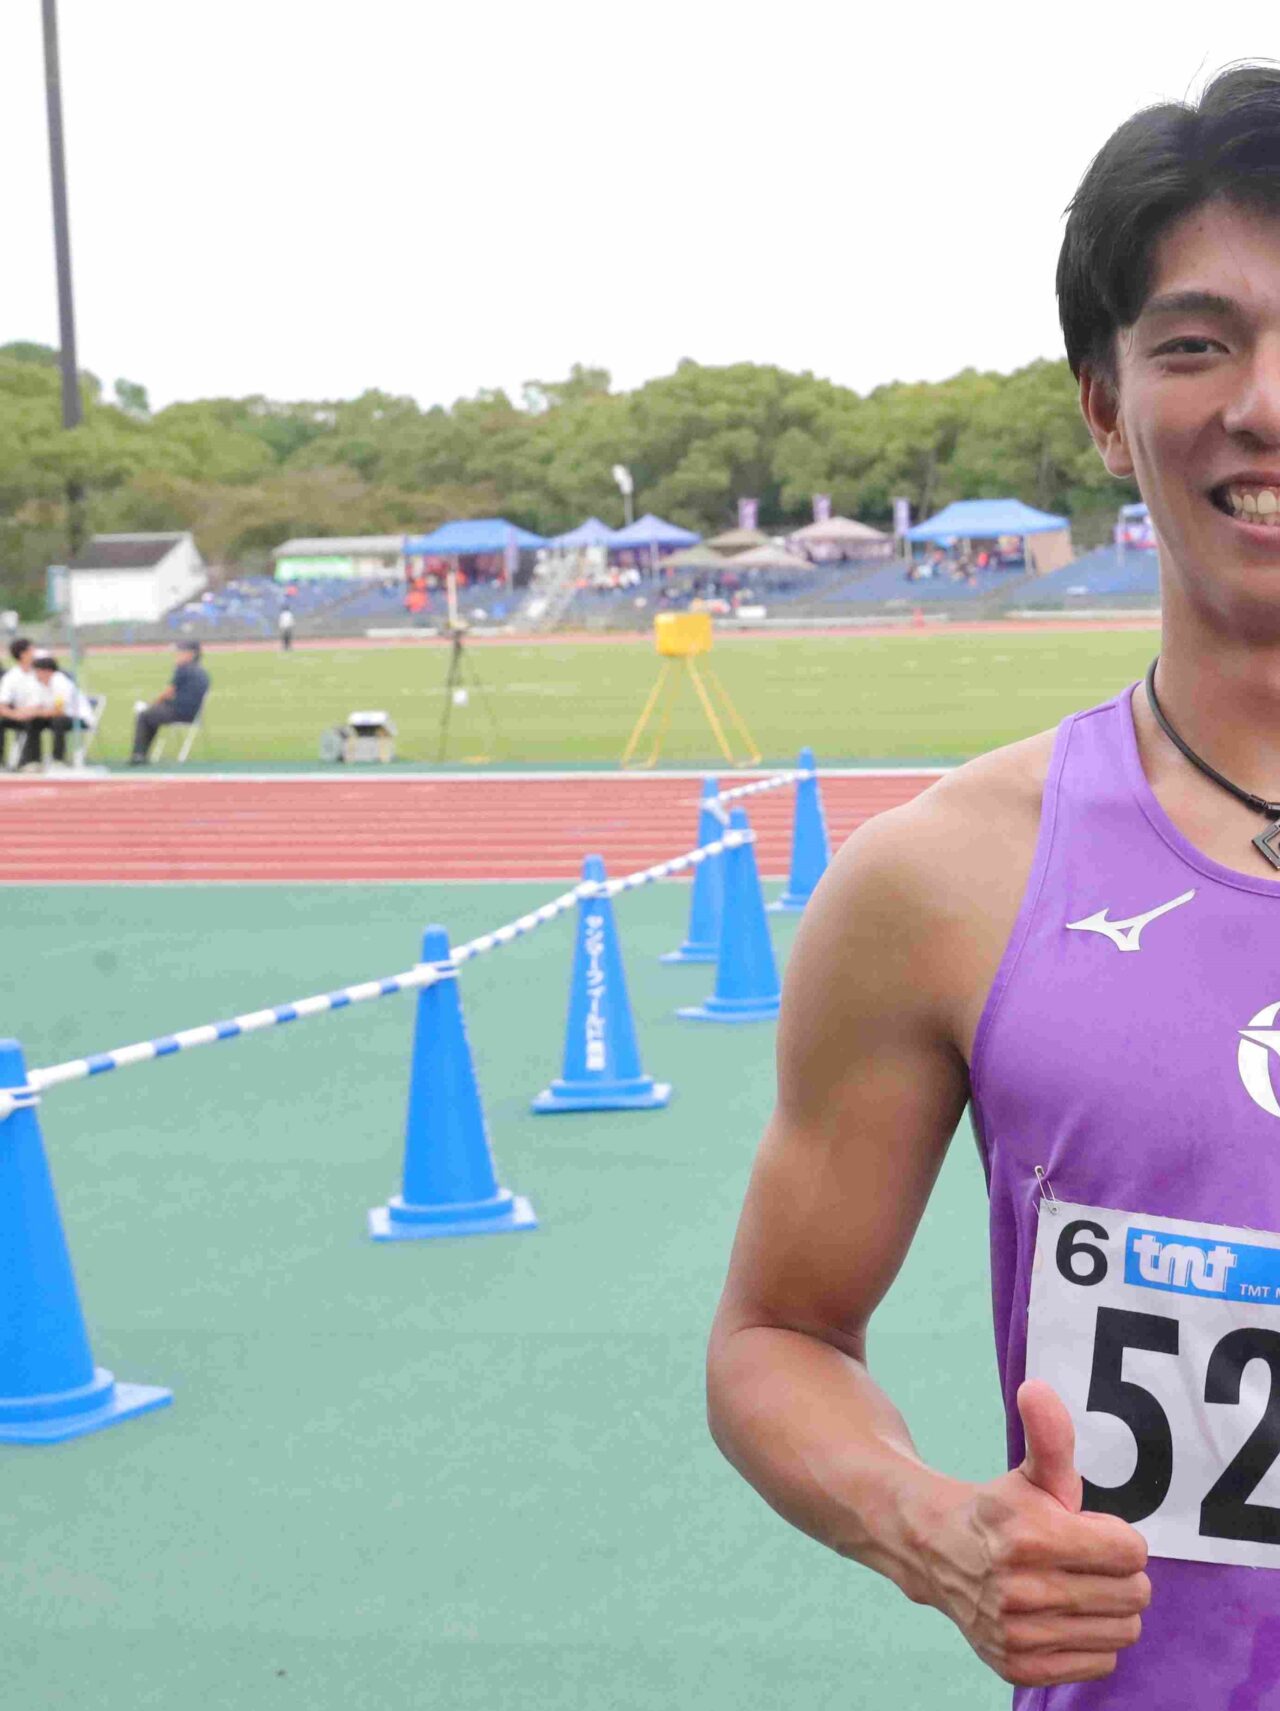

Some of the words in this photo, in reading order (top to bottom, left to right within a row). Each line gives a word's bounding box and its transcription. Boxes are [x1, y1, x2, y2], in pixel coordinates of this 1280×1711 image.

[1056, 1219, 1109, 1286] 6
[1133, 1234, 1238, 1293] tmt
[1239, 1283, 1271, 1298] TMT
